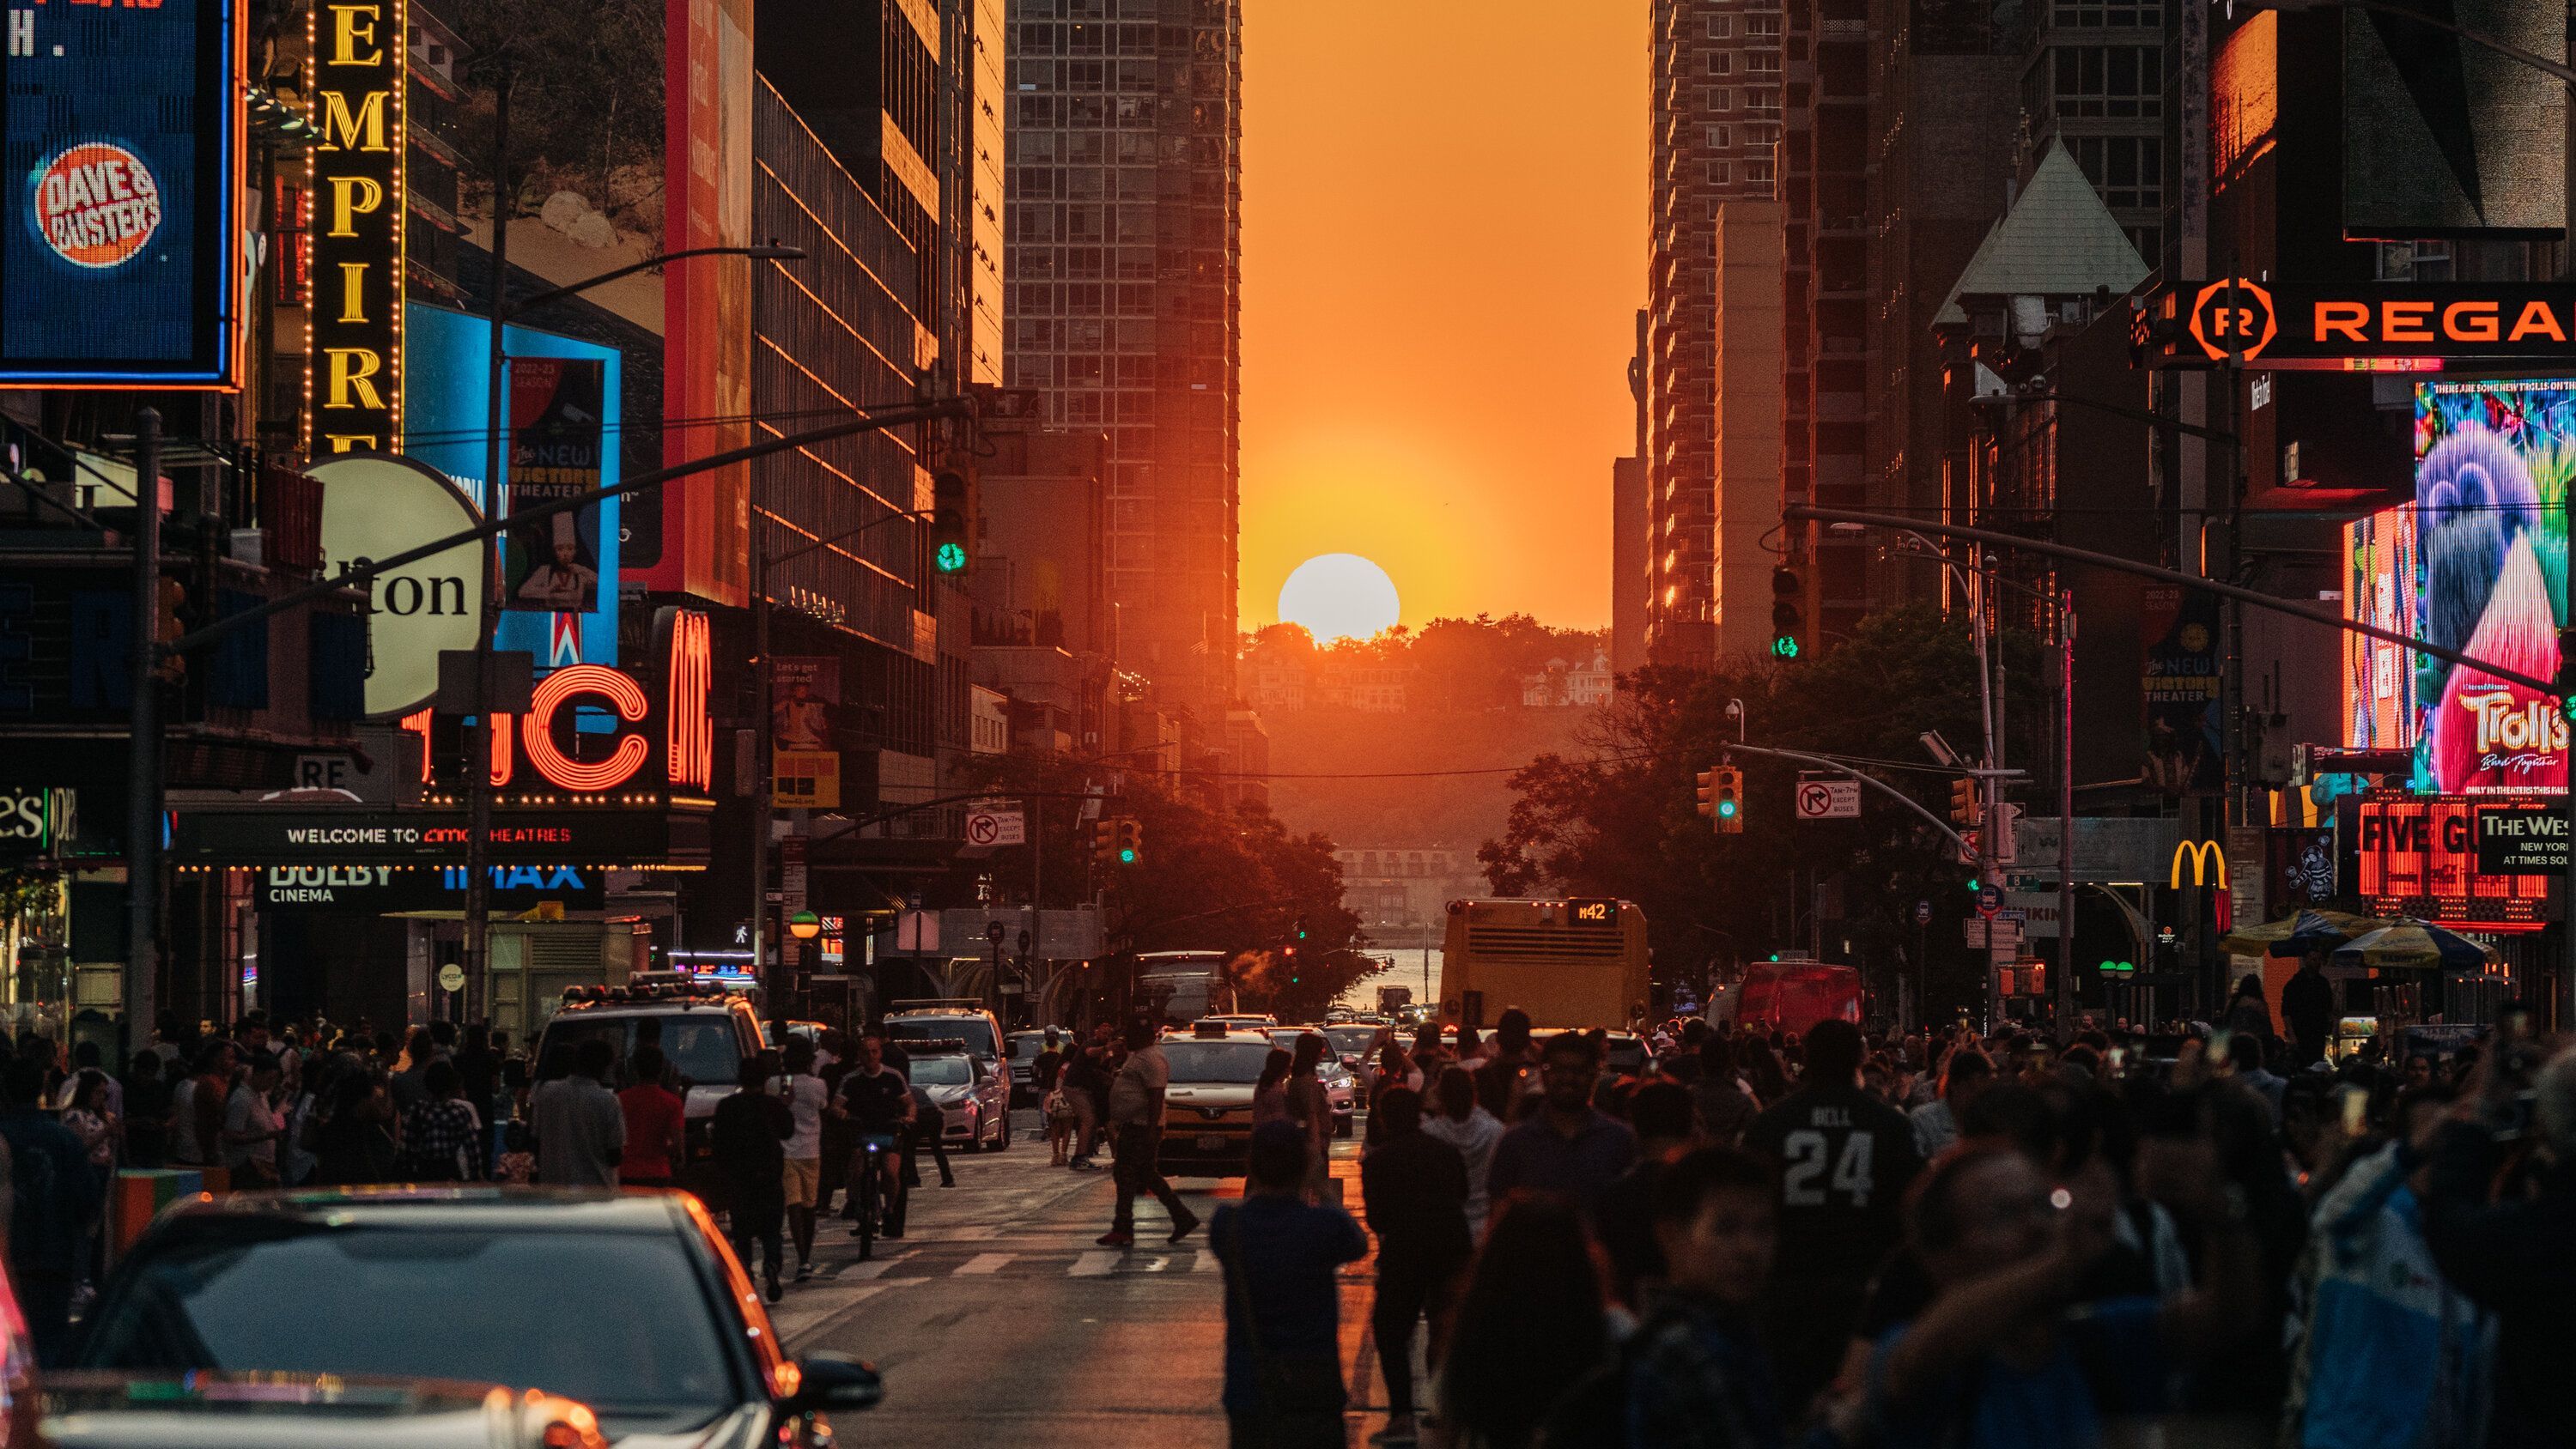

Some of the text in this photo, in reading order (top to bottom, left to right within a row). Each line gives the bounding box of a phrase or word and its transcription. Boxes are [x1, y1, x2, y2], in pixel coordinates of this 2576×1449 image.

[46, 161, 131, 216] DAVE
[2314, 300, 2576, 343] REGA
[2564, 381, 2576, 390] TH
[538, 445, 591, 466] NEW
[2458, 690, 2570, 755] Trolls
[288, 828, 386, 844] WELCOME
[392, 828, 419, 843] TO
[489, 828, 572, 843] HEATRES
[2362, 815, 2430, 852] FIVE
[2482, 815, 2524, 836] THE
[2520, 842, 2568, 852] NEW YOR
[2503, 856, 2518, 865] AT
[2518, 856, 2548, 865] TIMES
[269, 888, 335, 902] CINEMA
[1578, 904, 1606, 919] M42
[1783, 1129, 1875, 1208] 24
